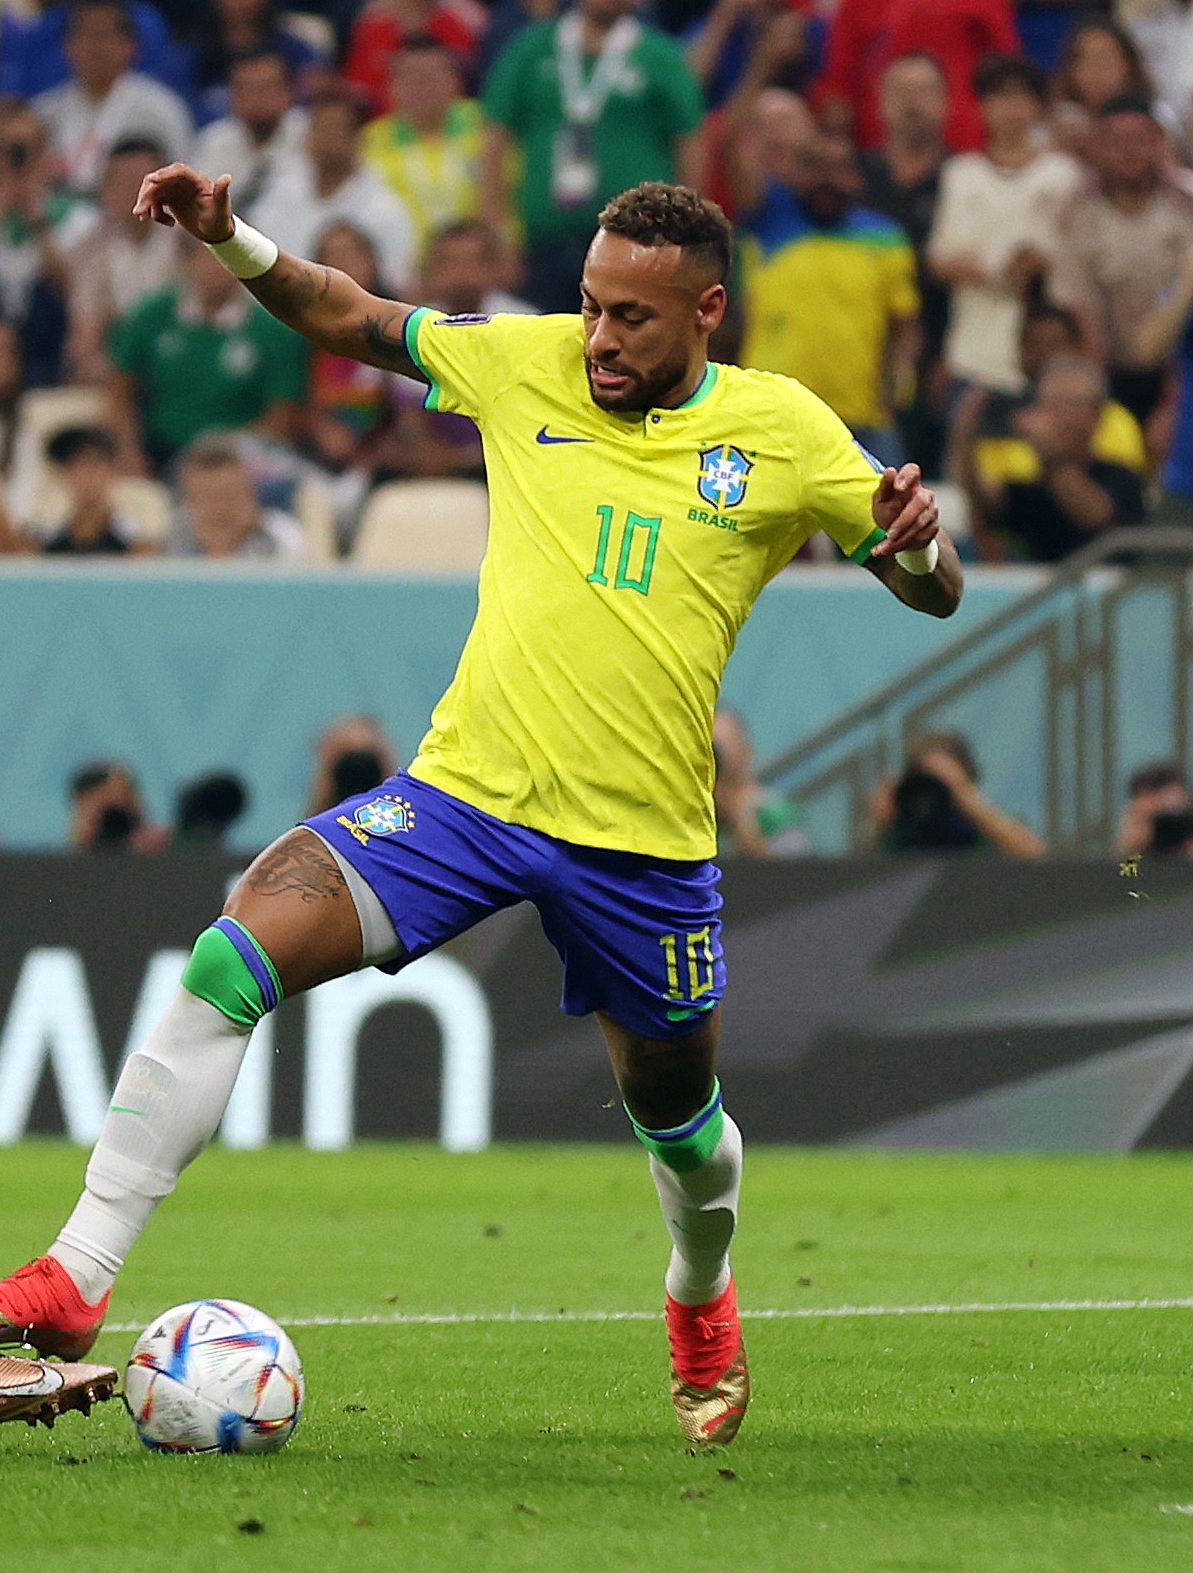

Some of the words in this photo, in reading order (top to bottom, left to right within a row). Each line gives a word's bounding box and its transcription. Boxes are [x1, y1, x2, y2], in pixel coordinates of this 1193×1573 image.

[713, 470, 734, 480] CBF
[687, 508, 739, 532] BRASIL
[586, 504, 663, 597] 10
[658, 925, 714, 1001] 10
